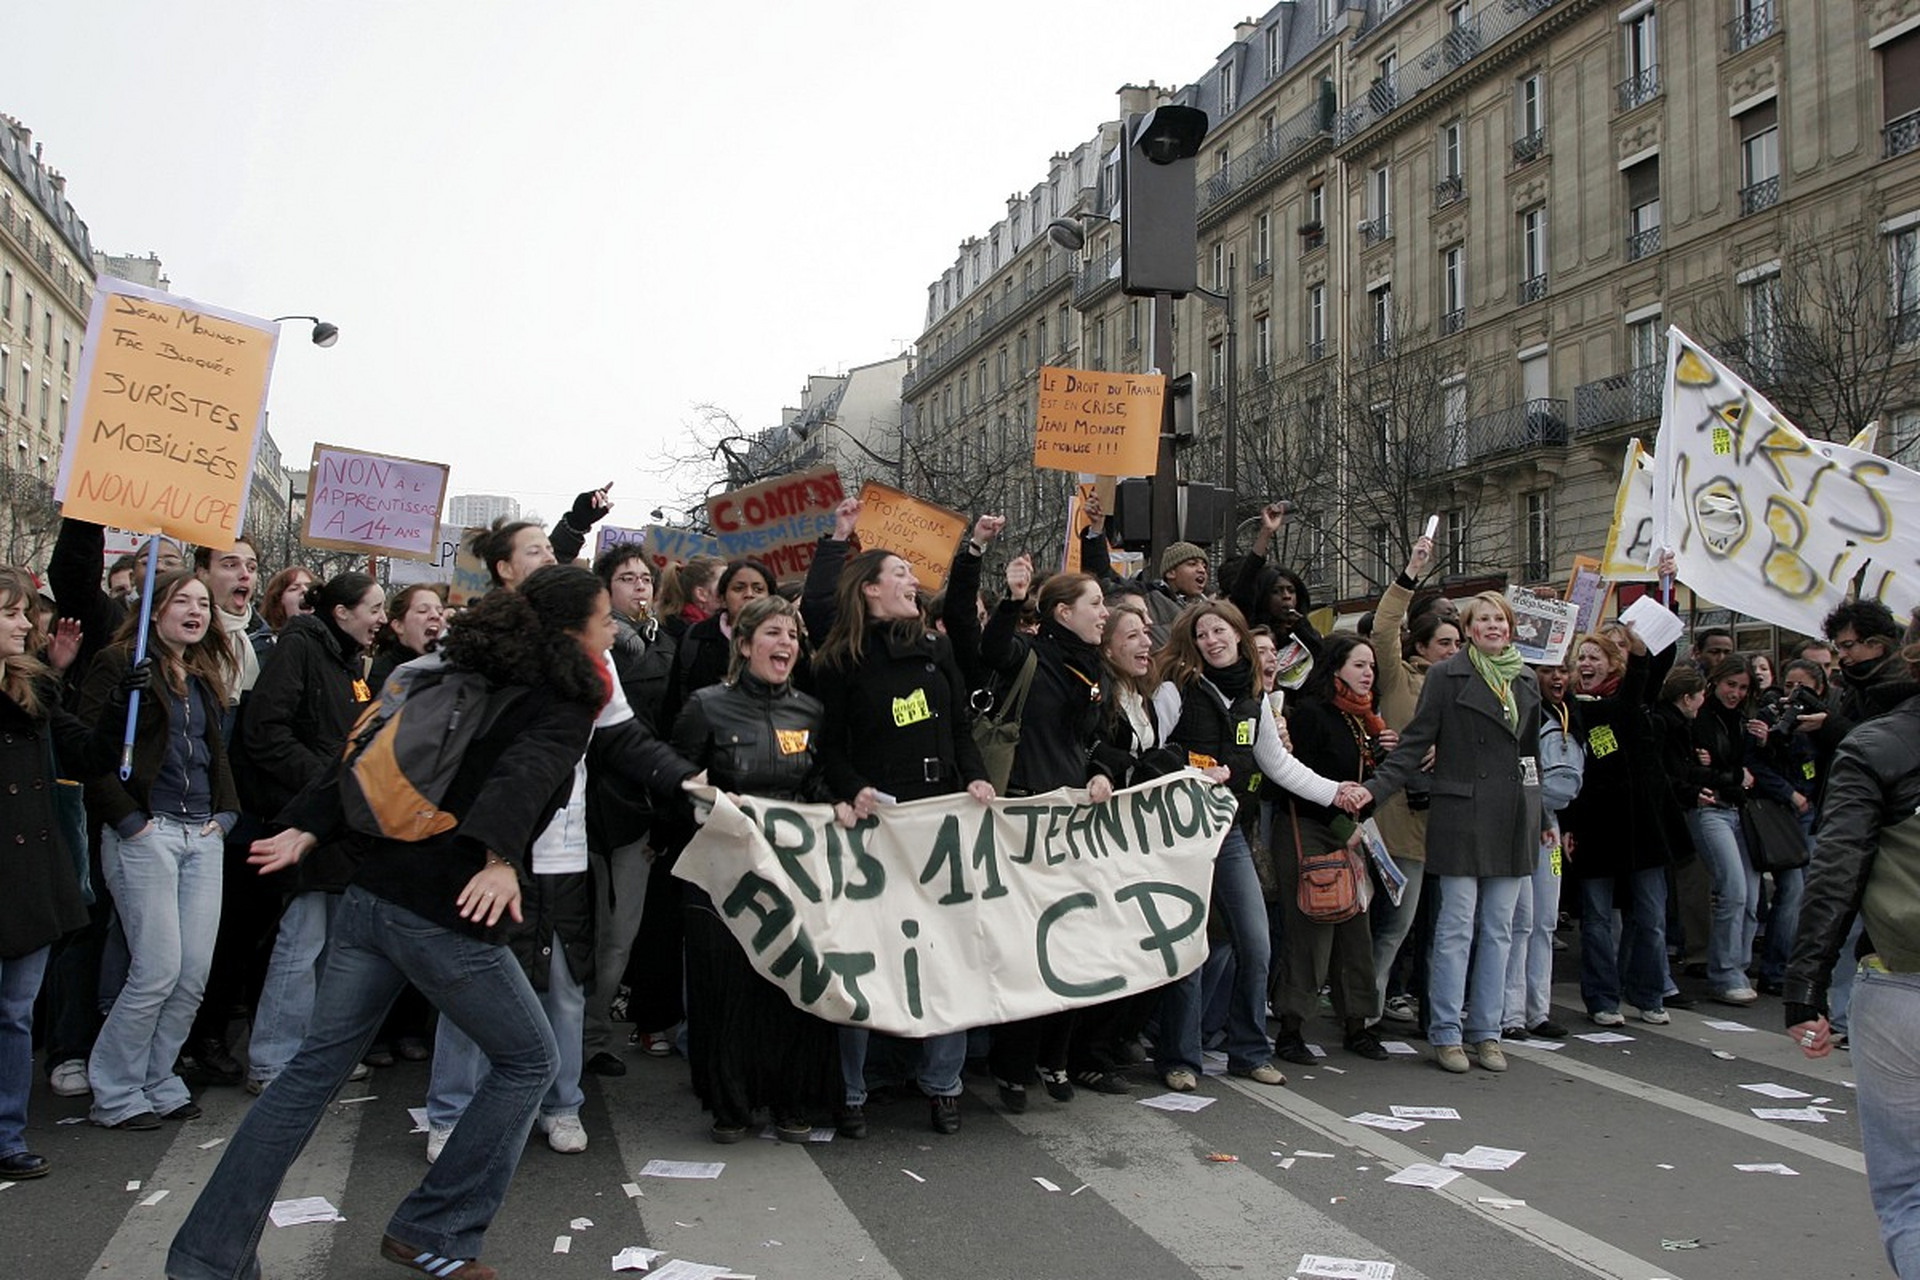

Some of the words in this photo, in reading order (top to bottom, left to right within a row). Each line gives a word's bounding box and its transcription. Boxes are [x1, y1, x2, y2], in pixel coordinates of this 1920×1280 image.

[1043, 373, 1057, 392] LE
[1065, 375, 1099, 393] DROIT
[1107, 384, 1122, 395] DU
[1064, 401, 1078, 410] EN
[1037, 416, 1068, 432] JEAN
[1074, 419, 1126, 436] MONNET
[323, 457, 391, 489] NON
[77, 470, 149, 510] NON
[151, 484, 192, 521] AU
[194, 494, 238, 531] CPE
[350, 517, 391, 540] 14
[394, 527, 421, 540] ANS
[883, 521, 918, 543] NOUS
[919, 806, 1009, 906] 11
[1003, 796, 1129, 866] JEAN
